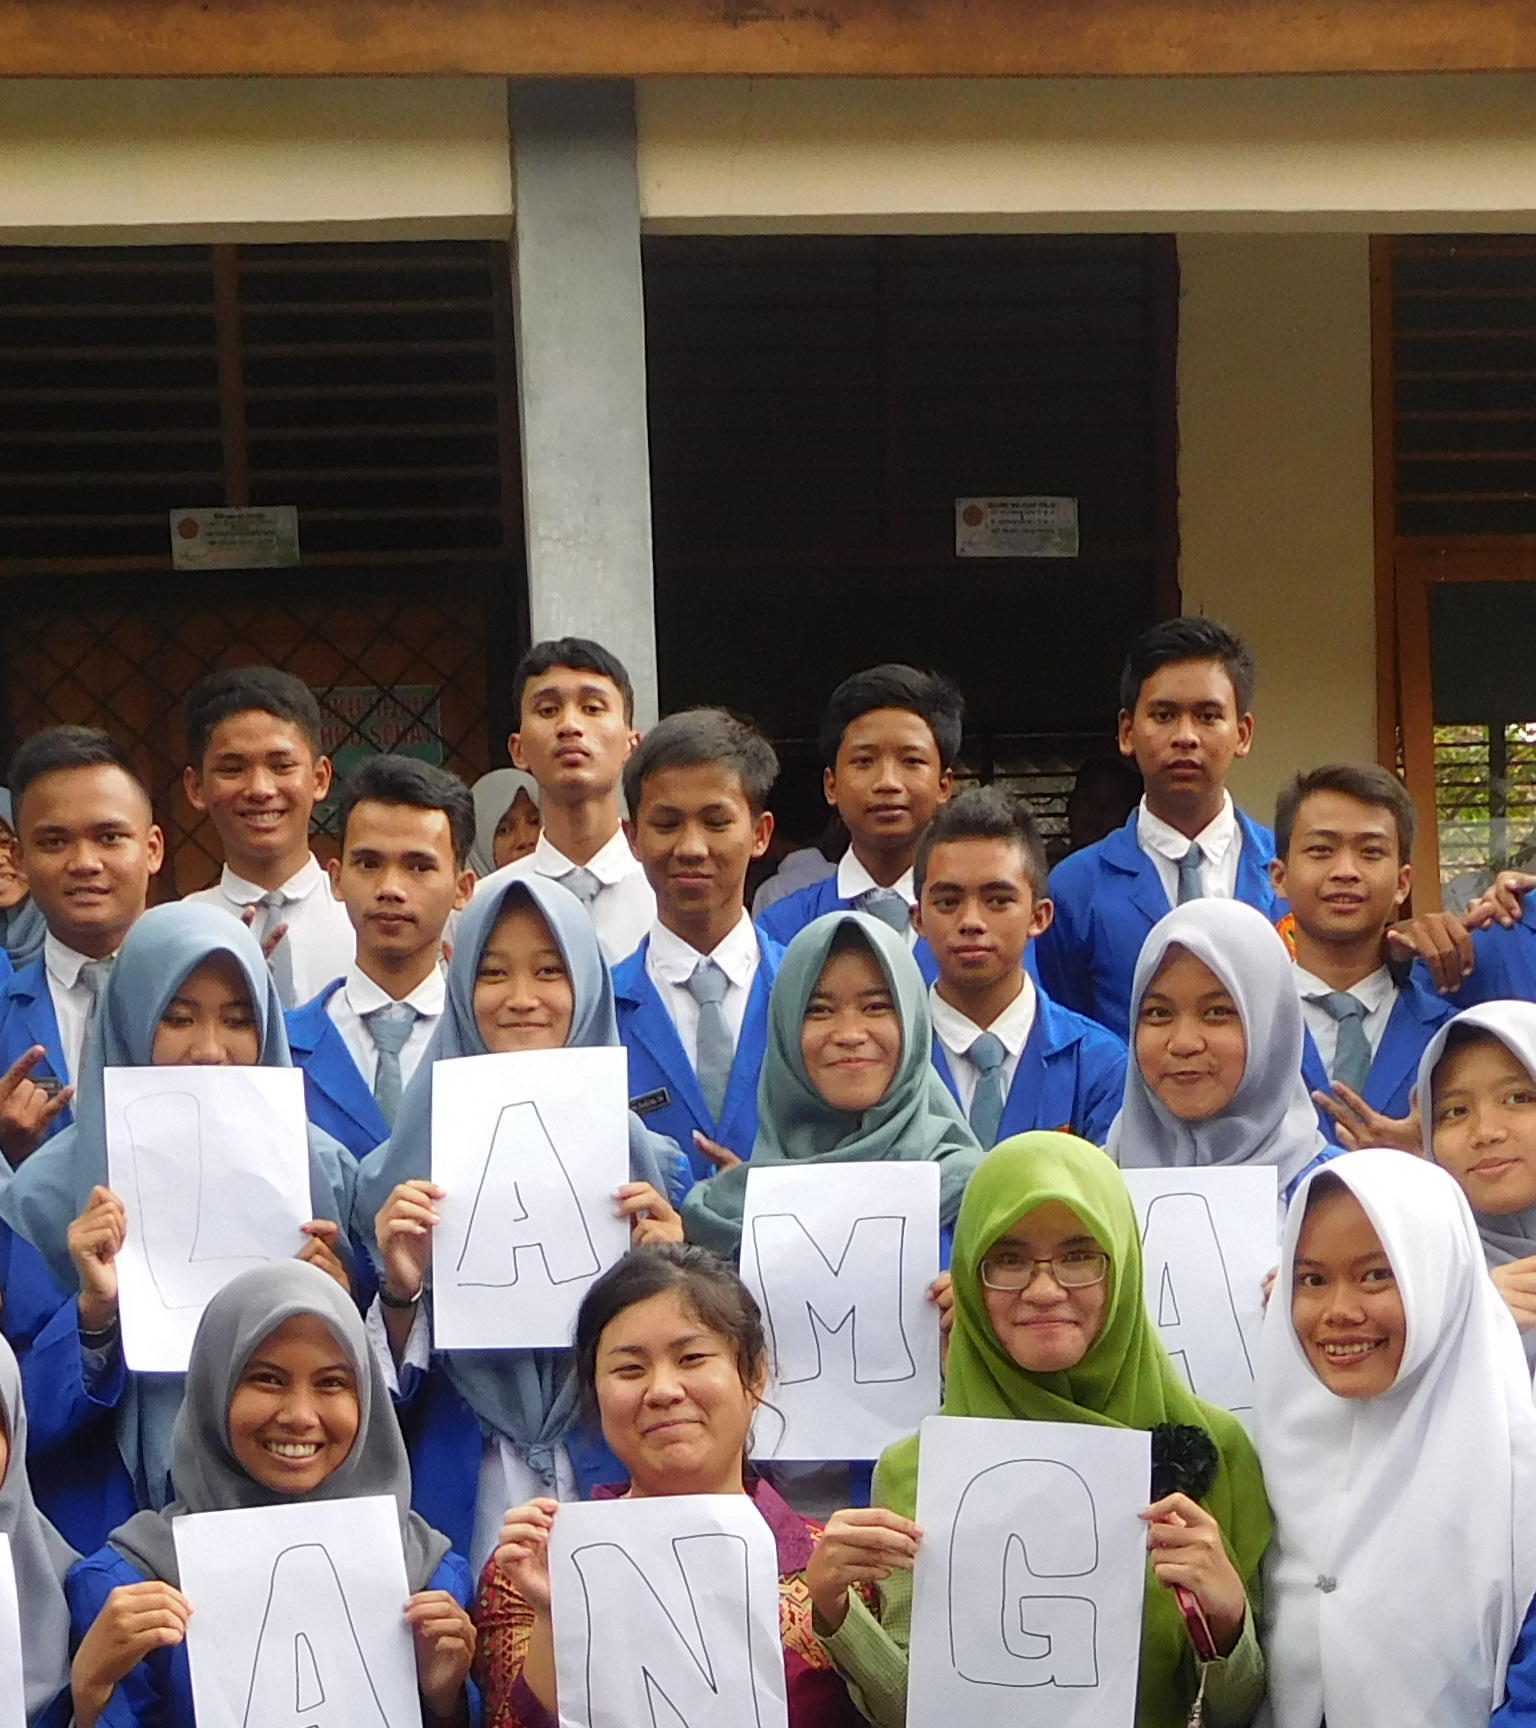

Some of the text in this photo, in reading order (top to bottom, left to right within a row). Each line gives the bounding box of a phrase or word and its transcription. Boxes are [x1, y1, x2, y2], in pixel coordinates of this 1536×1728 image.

[123, 1090, 270, 1310] L
[456, 1101, 600, 1288] A
[748, 1214, 916, 1385] M
[1136, 1192, 1256, 1412] A
[946, 1458, 1100, 1688] G
